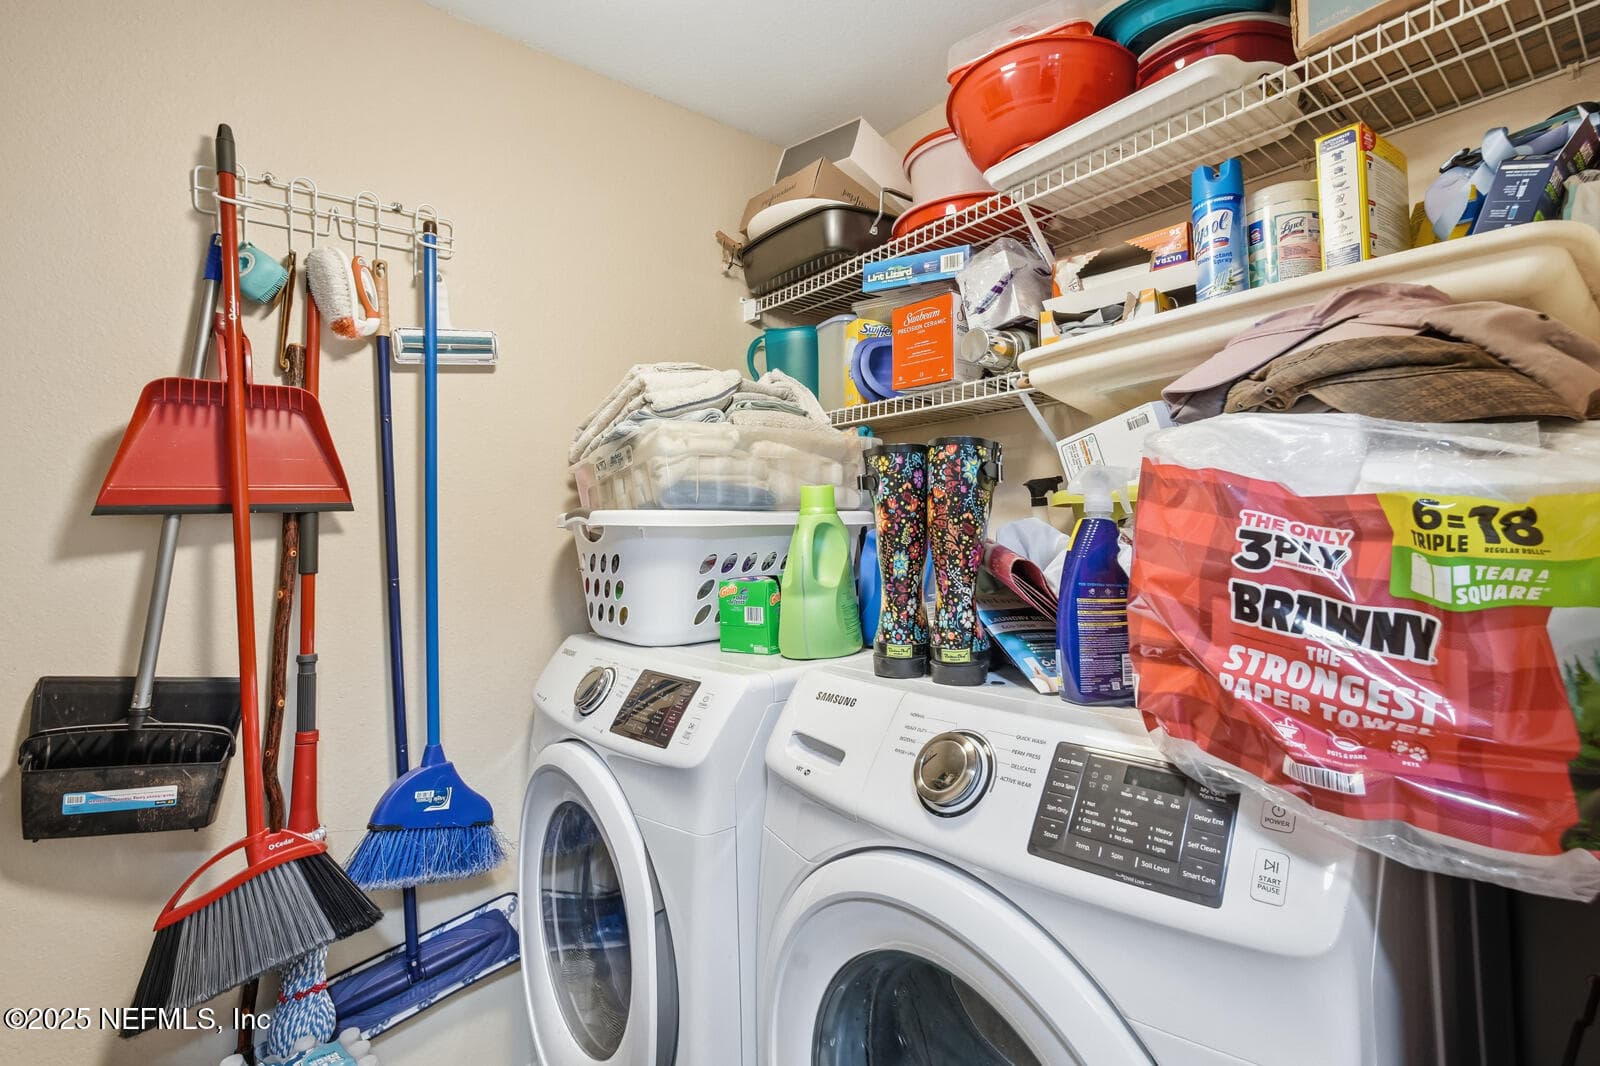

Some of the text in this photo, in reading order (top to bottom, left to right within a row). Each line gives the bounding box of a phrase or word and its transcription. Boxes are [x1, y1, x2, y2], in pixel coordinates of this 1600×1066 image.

[1281, 216, 1304, 234] Lysol
[1155, 254, 1182, 266] ULTRA
[867, 272, 884, 282] Lint
[885, 267, 912, 280] Lizard
[903, 308, 940, 326] Sunbeam
[898, 324, 923, 335] PRECISION
[924, 318, 947, 328] CERAMIC
[1243, 512, 1351, 546] THE ONLY
[1411, 530, 1469, 553] TRIPLE
[1475, 565, 1550, 583] TEAR A
[1456, 584, 1543, 605] SQUARE
[1231, 581, 1437, 661] BRAWNY
[1306, 646, 1341, 668] THE
[1222, 644, 1443, 726] STRONGEST
[816, 691, 857, 707] SAMSUNG
[1015, 734, 1047, 745] QUICK WASH
[1011, 749, 1041, 761] PERM PRESS
[1010, 763, 1037, 774] DELICATES
[1000, 775, 1032, 789] ACTIVE WEAR
[1120, 808, 1133, 816] High
[1118, 818, 1138, 827] Medium
[1194, 814, 1225, 826] Delay End
[1264, 816, 1290, 828] POWER
[1116, 825, 1127, 833] Low
[1156, 827, 1173, 837] Heavy
[1154, 836, 1173, 847] Normal
[1187, 841, 1200, 850] Self
[1151, 845, 1166, 854] Light
[1111, 852, 1124, 861] Spin
[1141, 860, 1170, 874] Soil Level
[1182, 870, 1216, 885] Smart Care
[1259, 875, 1281, 886] START
[1257, 883, 1280, 895] PAUSE
